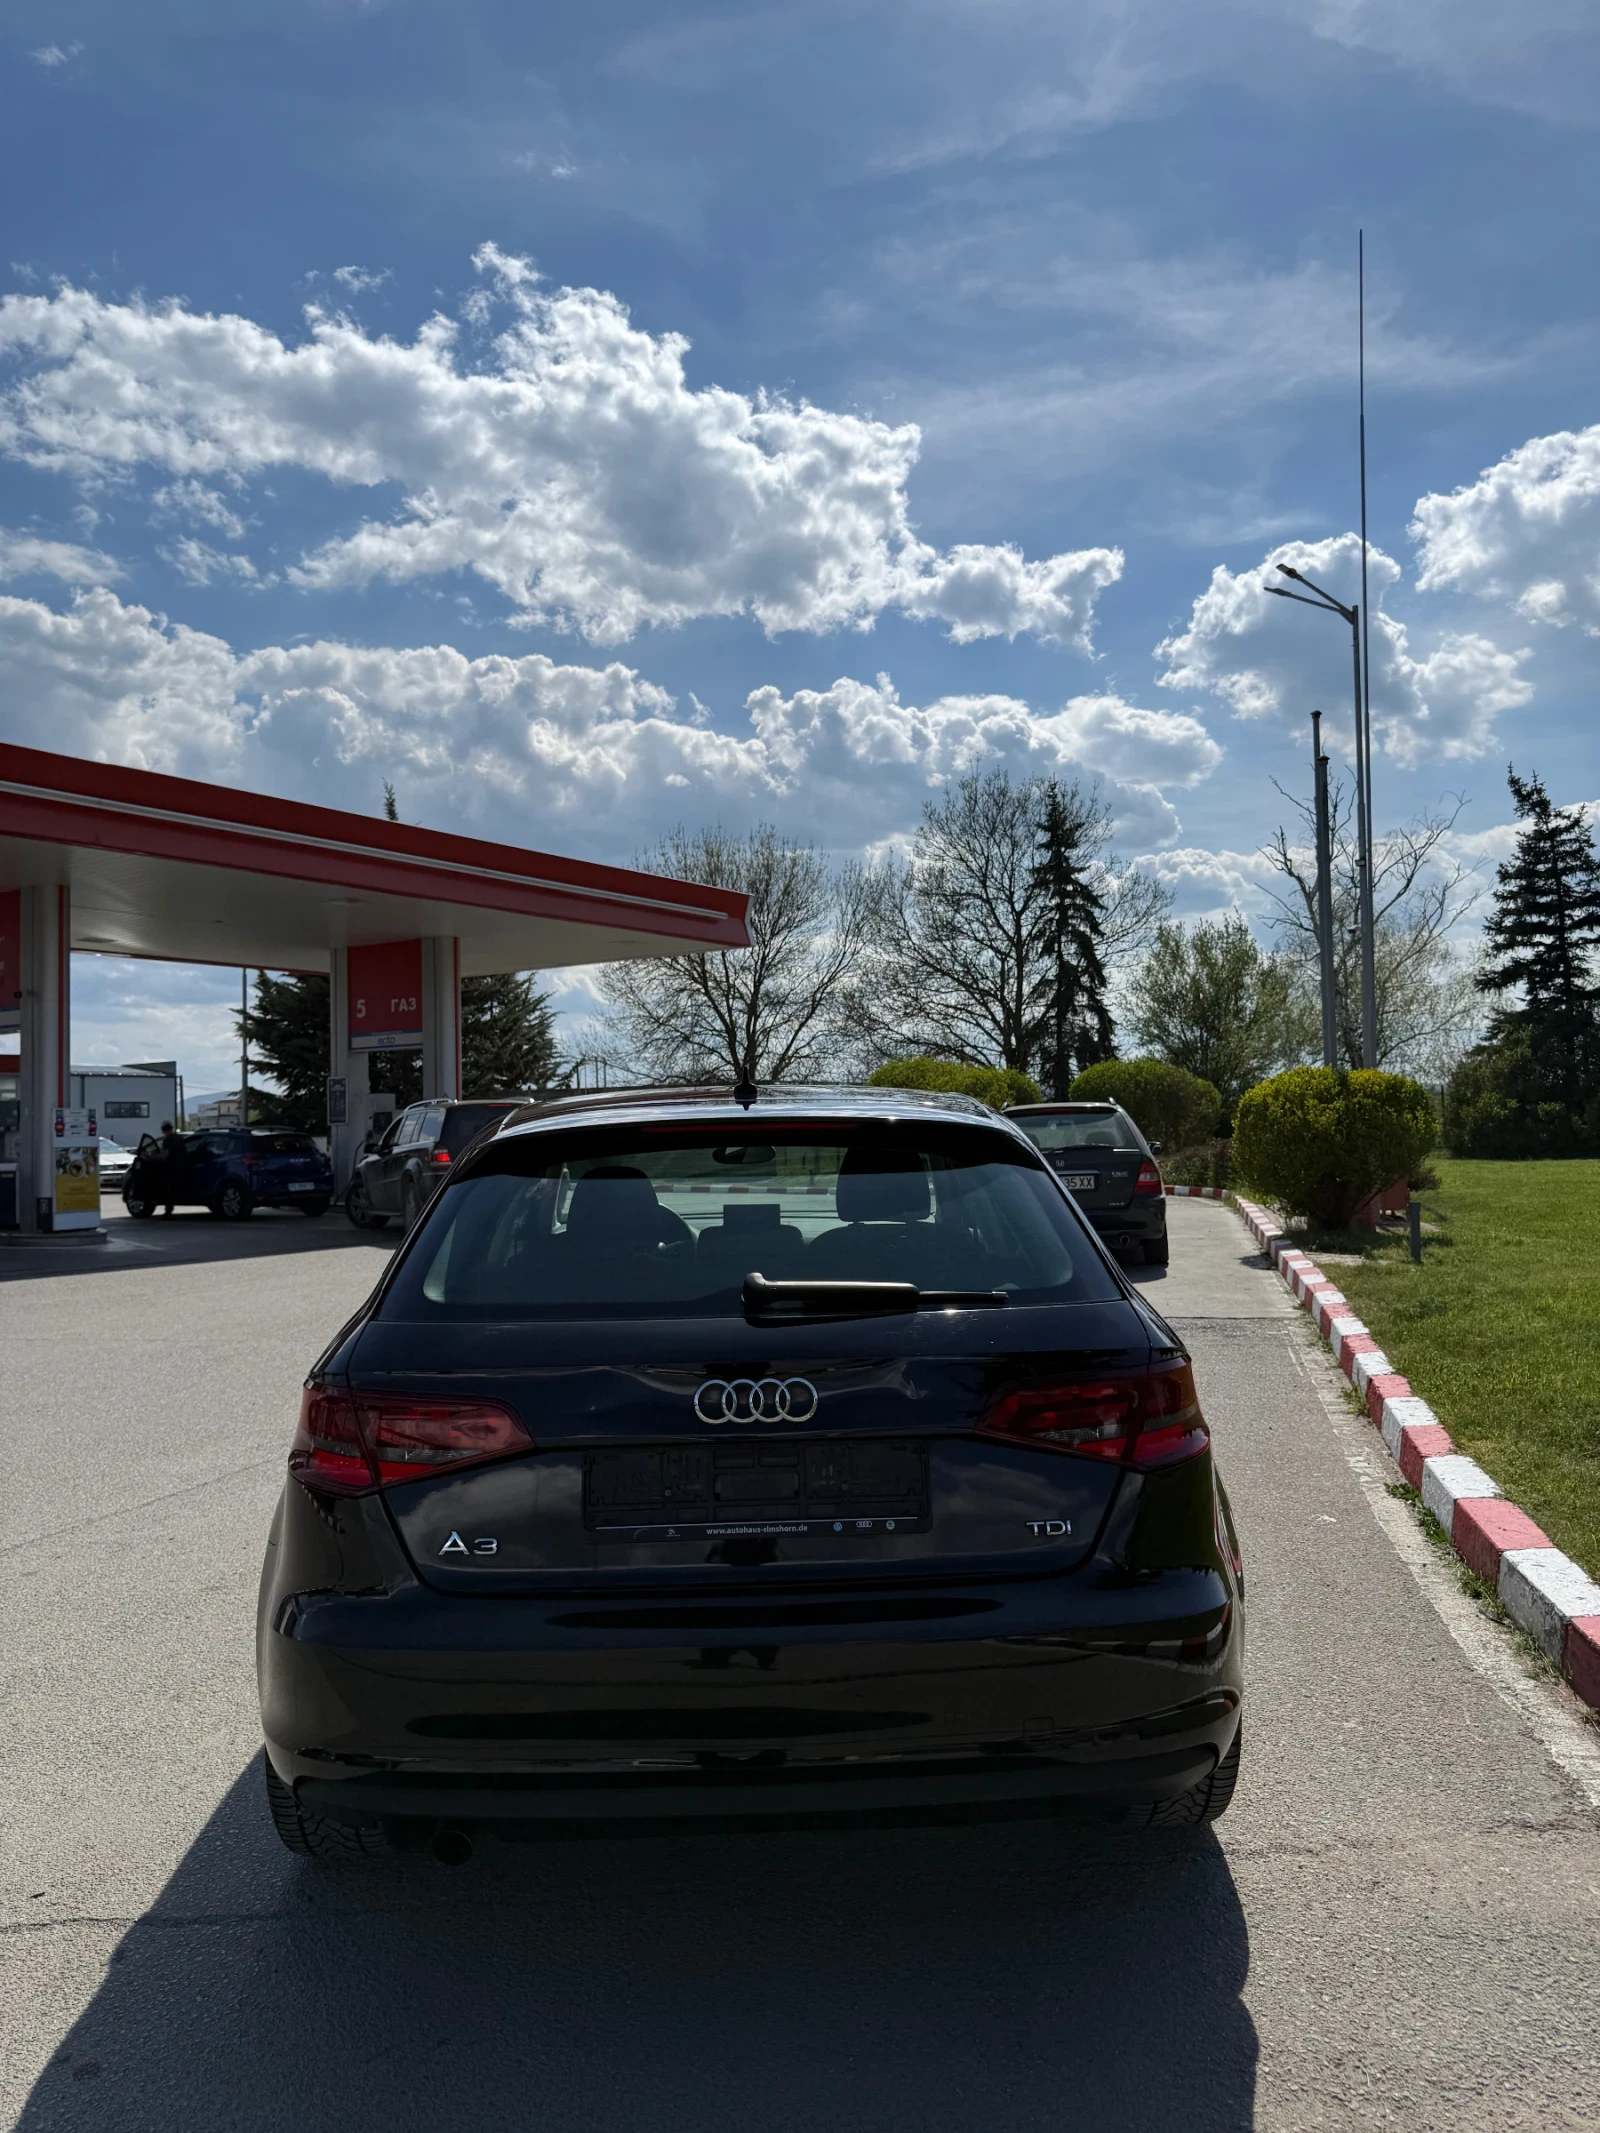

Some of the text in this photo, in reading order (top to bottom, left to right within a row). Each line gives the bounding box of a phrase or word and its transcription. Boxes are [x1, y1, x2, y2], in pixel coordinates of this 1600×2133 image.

[356, 997, 417, 1018] 5 ГАЗ
[706, 1524, 808, 1535] www.autohaus-elmshorn.de
[1026, 1520, 1072, 1536] TDI
[438, 1531, 498, 1555] A3
